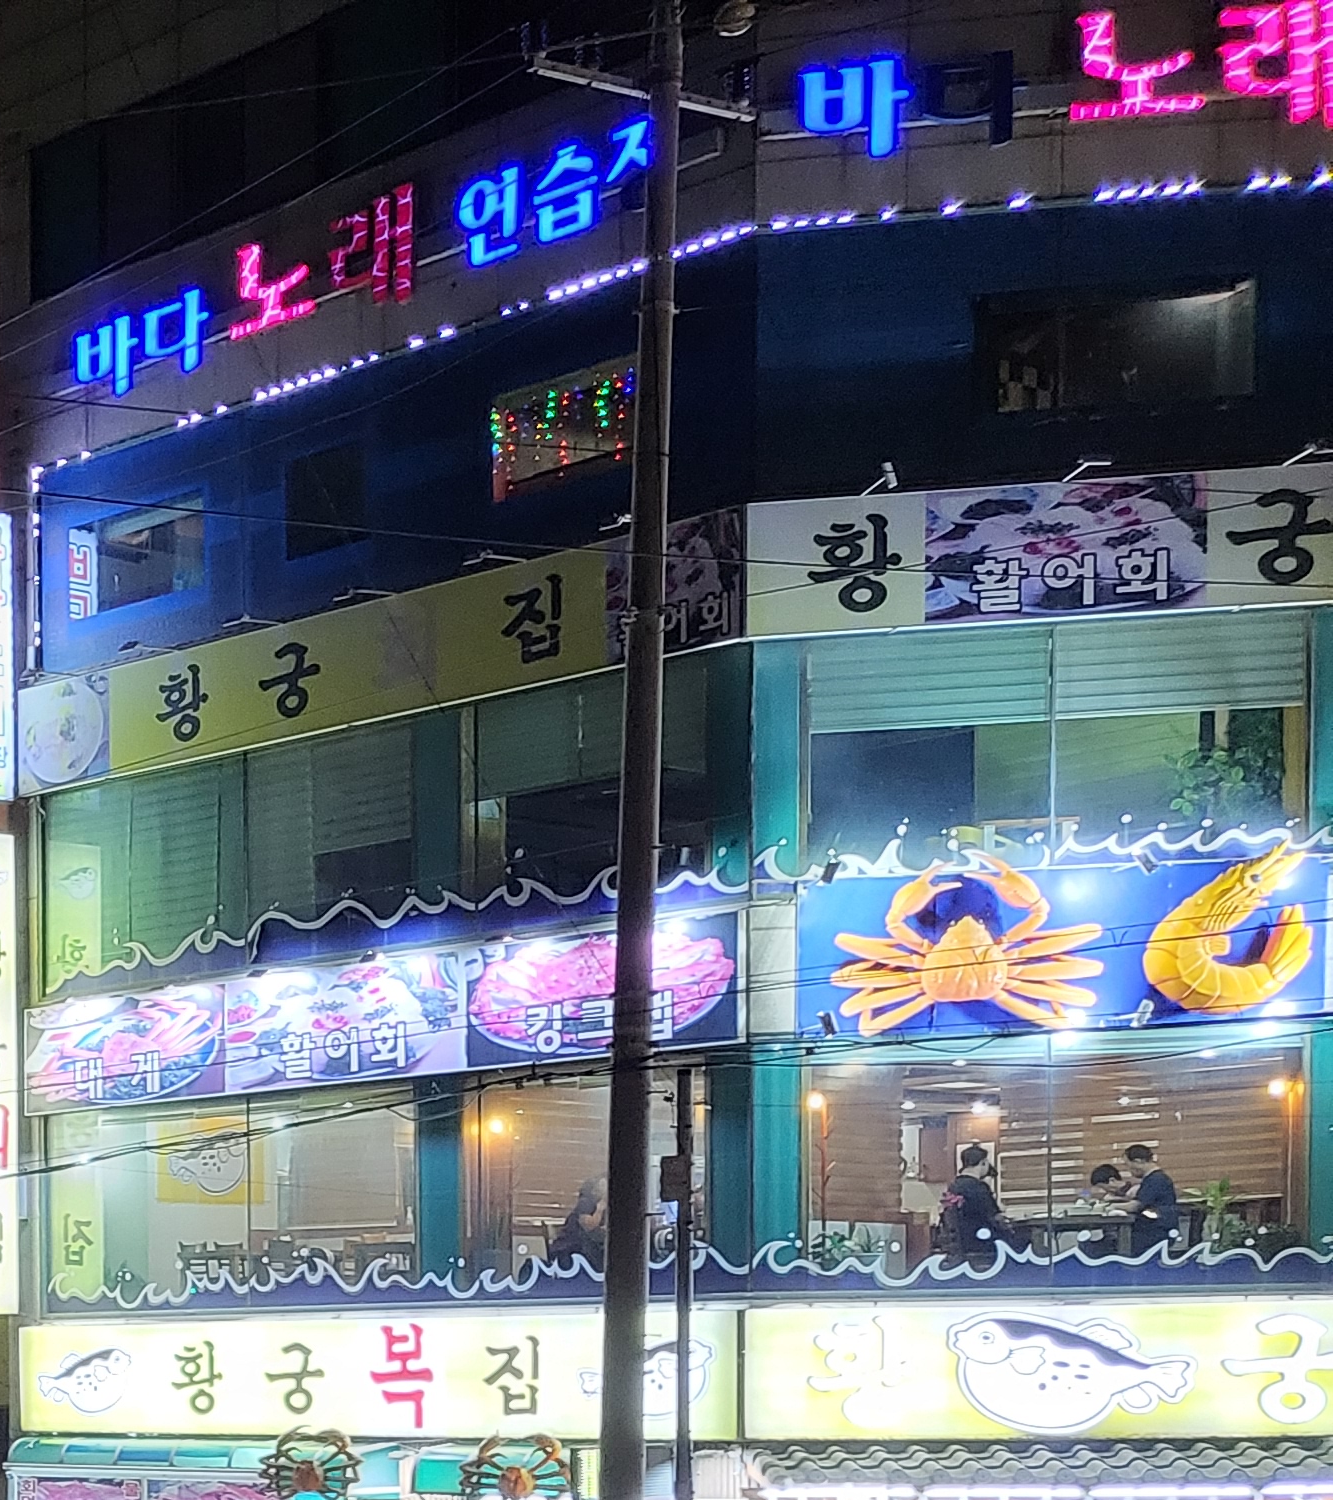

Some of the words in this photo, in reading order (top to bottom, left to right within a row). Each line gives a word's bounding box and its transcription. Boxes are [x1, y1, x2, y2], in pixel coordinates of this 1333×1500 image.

[74, 287, 211, 397] 바다
[230, 183, 414, 339] 노래
[973, 547, 1171, 614] 활어회
[619, 590, 731, 647] 어회
[73, 1050, 161, 1100] 대게
[281, 1022, 408, 1079] 활어회
